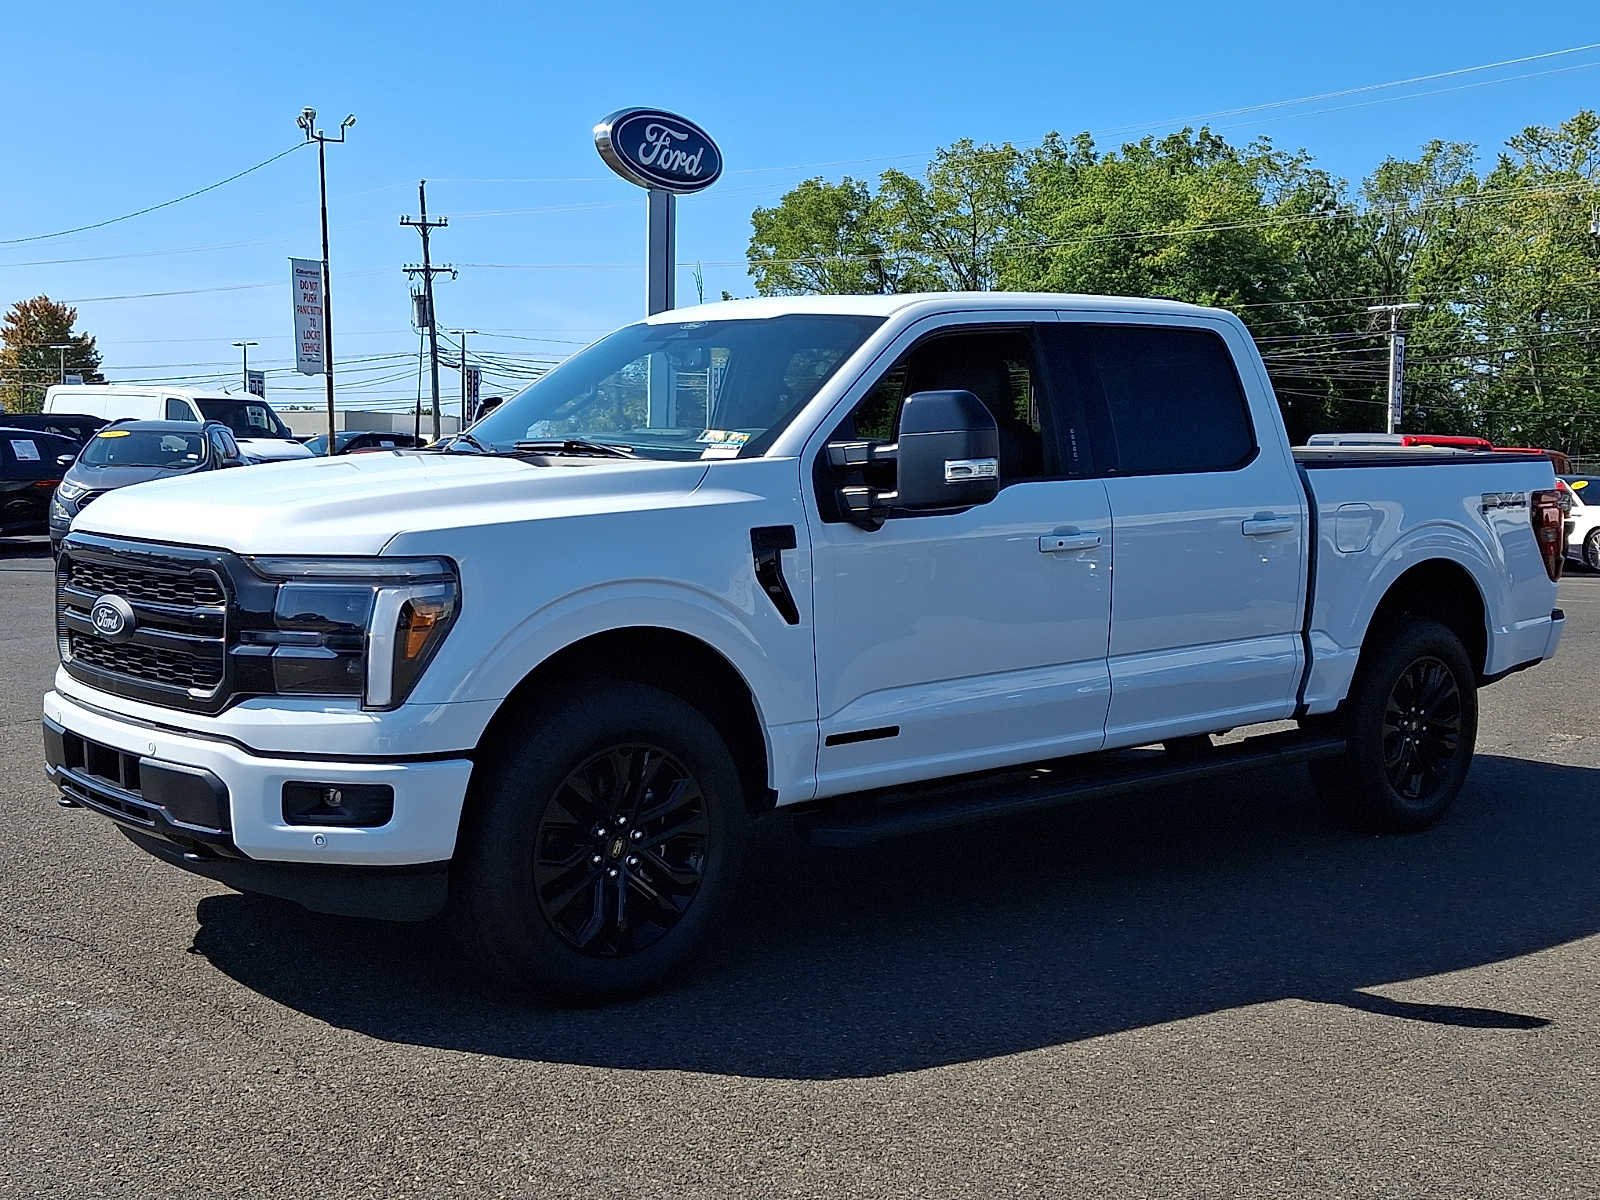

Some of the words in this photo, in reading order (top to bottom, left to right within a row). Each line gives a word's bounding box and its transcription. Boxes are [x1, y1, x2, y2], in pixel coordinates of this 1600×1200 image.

[638, 123, 704, 176] Ford
[300, 280, 309, 290] DO
[303, 292, 317, 303] PUSH
[310, 318, 316, 328] TO
[97, 608, 118, 629] Ford
